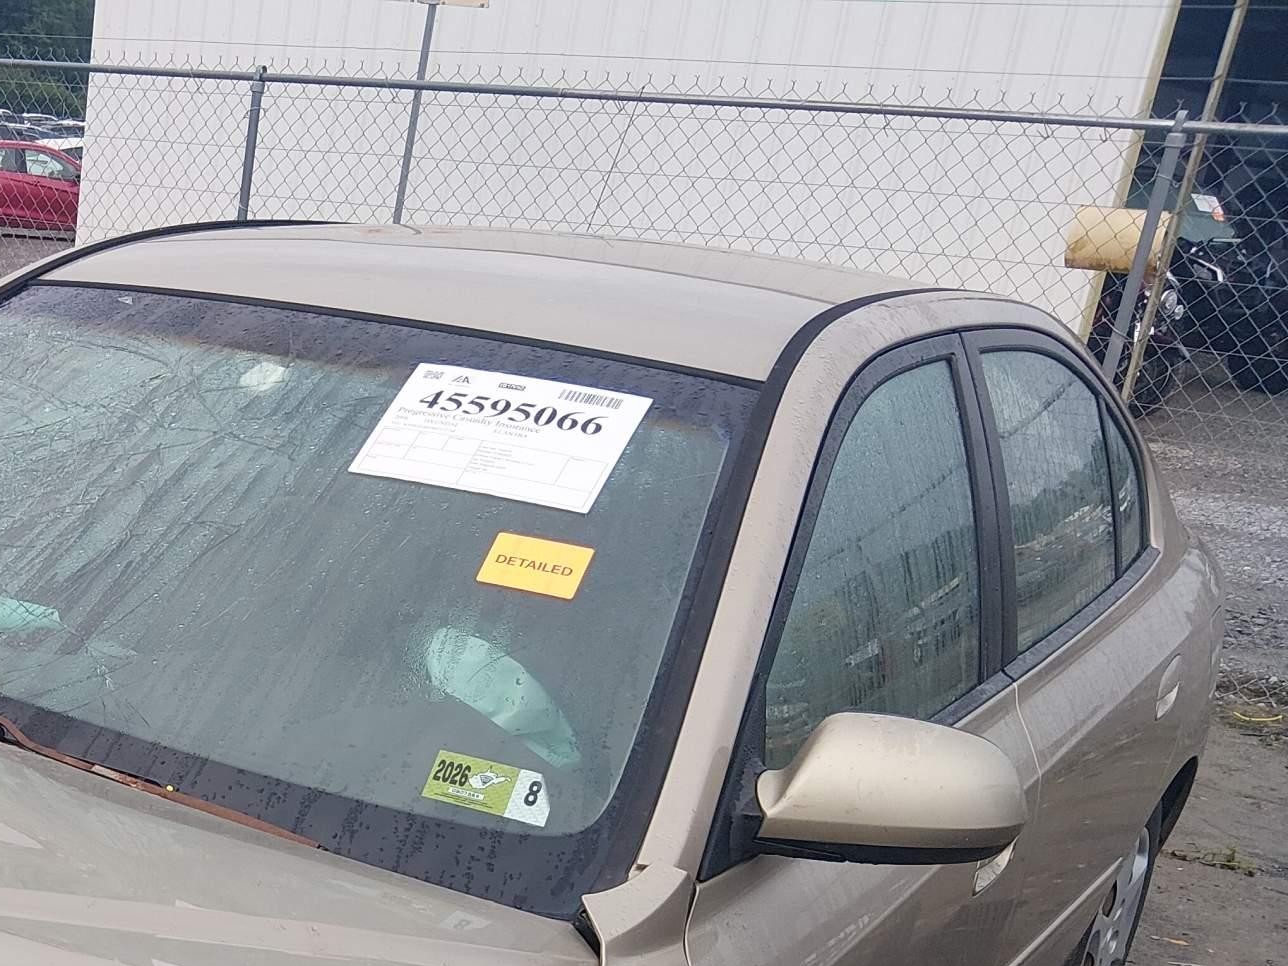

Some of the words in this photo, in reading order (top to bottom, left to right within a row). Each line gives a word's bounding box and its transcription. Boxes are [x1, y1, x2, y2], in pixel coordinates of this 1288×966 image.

[399, 406, 450, 421] Progressive
[496, 420, 541, 435] Insurance
[418, 390, 608, 436] 45595066
[495, 554, 573, 578] DETAILED
[432, 759, 472, 787] 2026
[523, 780, 543, 807] 8
